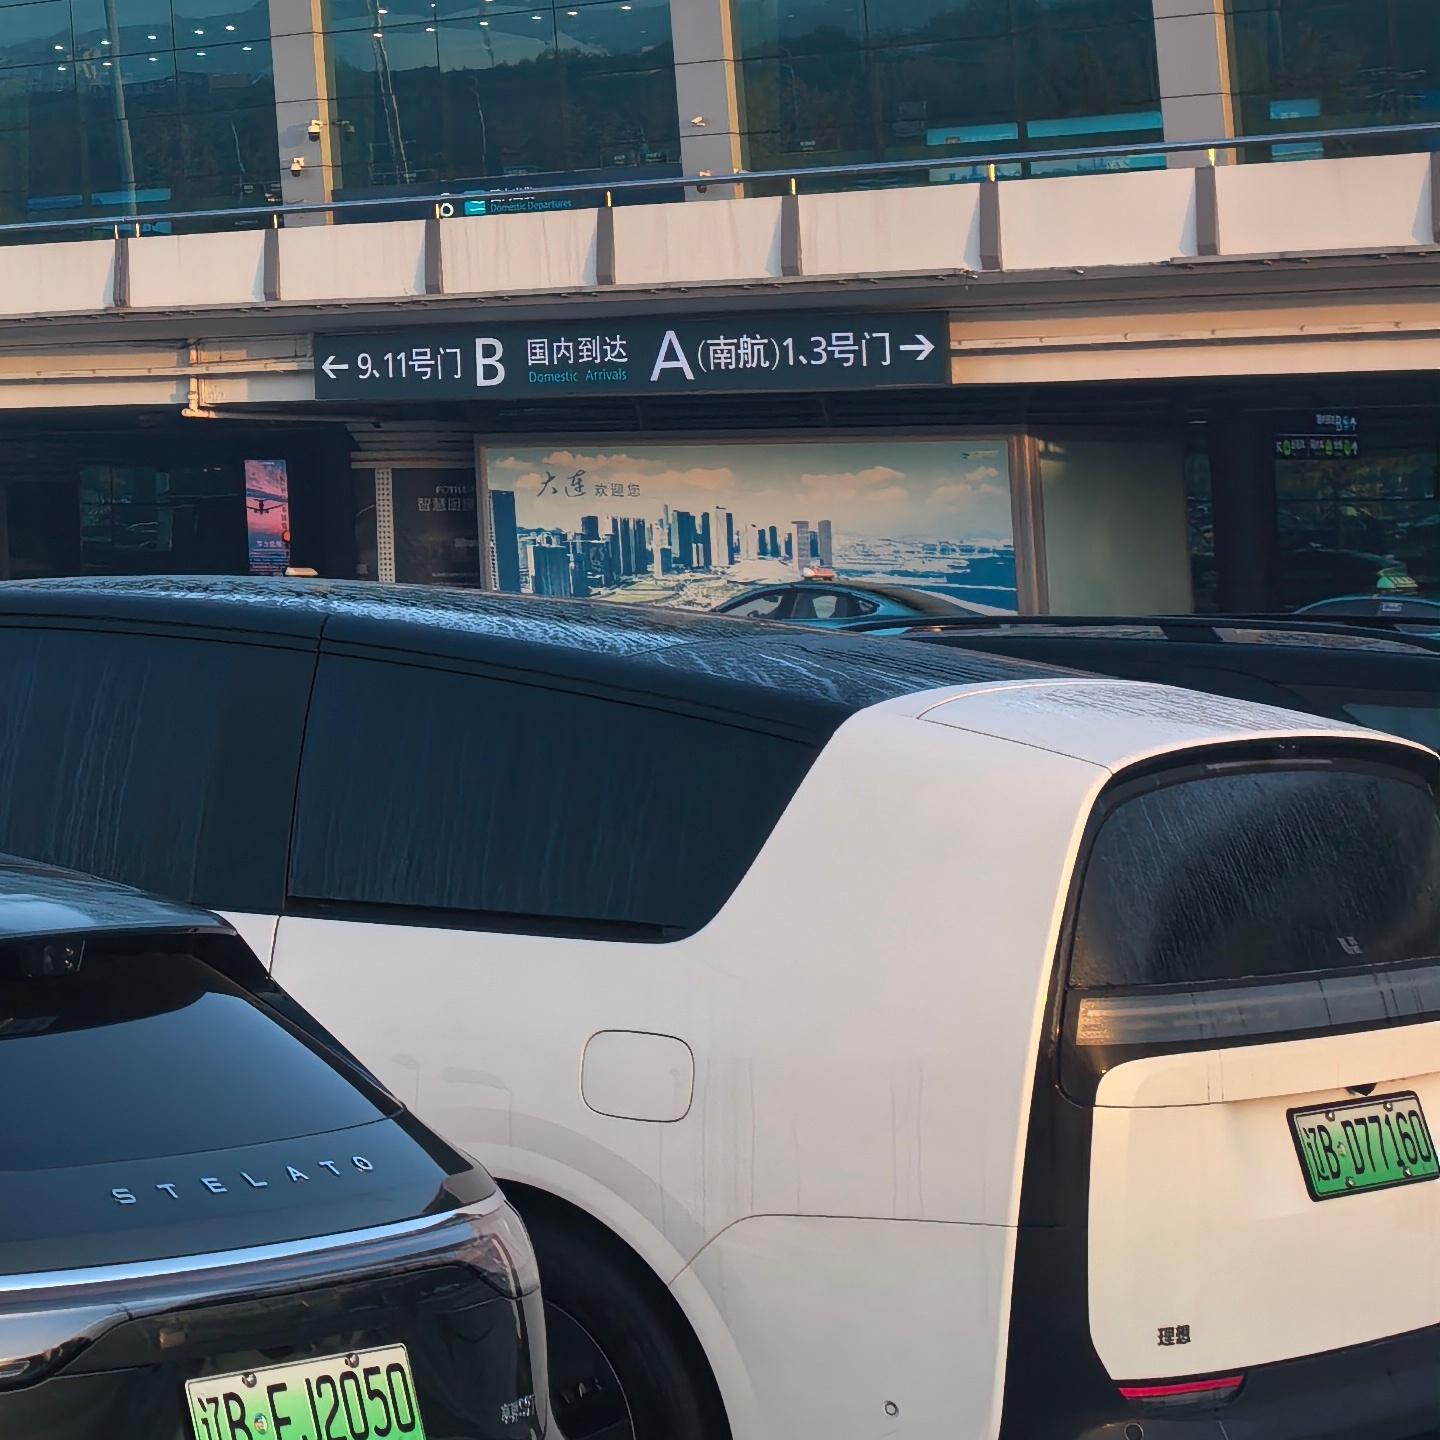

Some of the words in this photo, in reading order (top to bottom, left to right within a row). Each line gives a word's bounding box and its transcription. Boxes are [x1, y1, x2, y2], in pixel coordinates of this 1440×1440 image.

[490, 203, 526, 213] Domestic
[527, 199, 572, 211] Departures
[476, 337, 505, 387] B
[527, 334, 628, 367] 国内到达
[650, 330, 695, 382] A
[528, 371, 577, 384] Domestic
[585, 368, 627, 382] Arrivals
[595, 483, 640, 497] 欢迎您
[111, 1155, 374, 1205] STELATO
[1157, 1325, 1191, 1347] 理想
